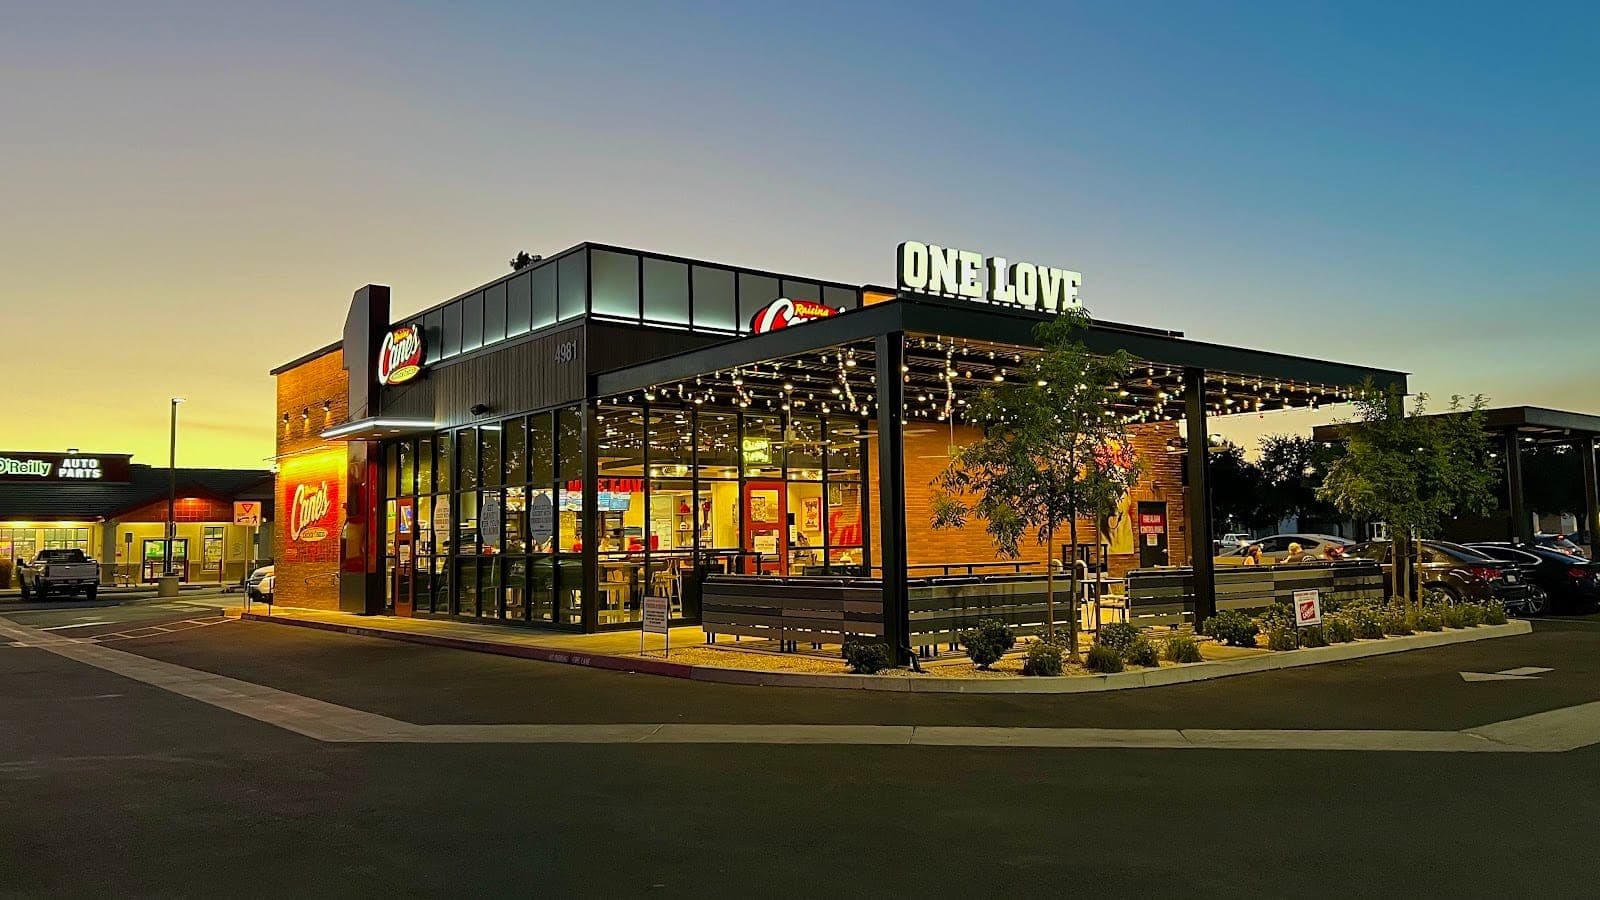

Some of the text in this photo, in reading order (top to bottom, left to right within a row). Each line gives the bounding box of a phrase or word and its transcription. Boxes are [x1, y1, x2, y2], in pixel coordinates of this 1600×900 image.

[901, 240, 1083, 312] ONE LOVE
[378, 324, 421, 386] Cane's
[554, 340, 577, 364] 4981
[58, 468, 103, 479] PARTS
[62, 458, 100, 469] AUTO
[291, 481, 331, 541] Cane's
